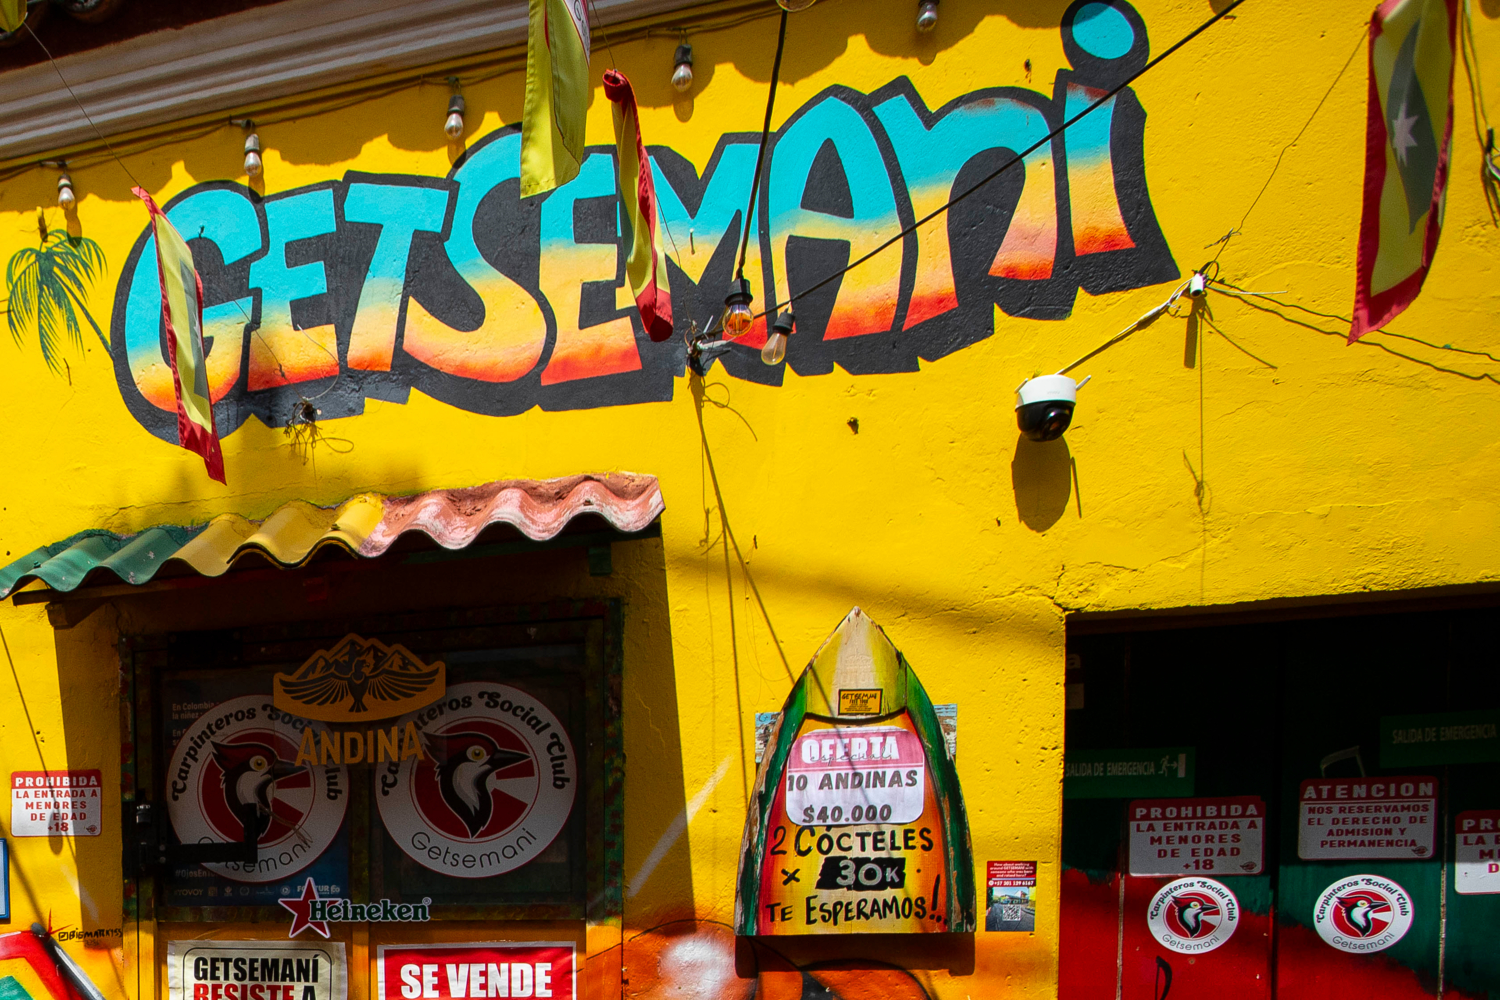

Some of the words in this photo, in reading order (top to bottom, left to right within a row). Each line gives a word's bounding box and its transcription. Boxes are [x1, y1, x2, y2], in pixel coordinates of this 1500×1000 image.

[477, 691, 551, 735] Social
[546, 732, 571, 790] Club
[1393, 728, 1423, 744] SALIDA
[1425, 727, 1437, 742] DE
[1440, 723, 1497, 741] EMERGENCIA
[171, 706, 257, 801] Carpinteros
[261, 703, 320, 746] Soci
[325, 758, 343, 801] lub
[294, 720, 425, 767] ANDINA
[801, 736, 900, 764] OFERTA
[1065, 762, 1092, 777] SALIDA
[1094, 762, 1104, 776] DE
[1106, 761, 1155, 776] EMERGENCIA
[15, 776, 98, 787] PROHIBIDA
[787, 774, 808, 791] 10
[818, 770, 918, 790] ANDINAS
[34, 789, 86, 798] ENTRADA
[91, 789, 98, 798] A
[1303, 782, 1433, 799] ATENCION
[25, 801, 87, 810] MENORES
[802, 804, 892, 823] $40.000
[1135, 804, 1258, 819] PROHIBIDA
[1308, 806, 1333, 814] NOS
[1338, 804, 1429, 814] RESERVAMOS
[31, 813, 46, 821] DE
[53, 812, 87, 821] EDAD
[1307, 818, 1324, 826] EL
[1331, 816, 1401, 826] DERECHO
[1409, 815, 1428, 824] DE
[1462, 818, 1500, 831] PR
[48, 822, 69, 832] +18
[1136, 823, 1156, 832] LA
[1163, 820, 1240, 832] ENTRADA
[1247, 820, 1258, 829] A
[1327, 828, 1393, 837] ADMISION
[1398, 828, 1407, 836] Y
[770, 825, 787, 856] 2
[1150, 833, 1242, 845] MENORES
[1320, 839, 1417, 848] PERMANENCIA
[1463, 835, 1486, 846] LA
[198, 837, 312, 874] tsemani
[411, 827, 537, 869] Getsemani
[1157, 848, 1180, 858] DE
[1191, 847, 1240, 857] EDAD
[1479, 849, 1500, 859] M
[1183, 859, 1214, 870] +18
[1149, 881, 1195, 920] Carpinteros
[1196, 880, 1229, 900] Social
[1225, 898, 1236, 922] Club
[1316, 880, 1360, 923] Carpinteros
[1361, 878, 1398, 895] Social
[1396, 893, 1410, 916] Club
[308, 899, 429, 921] Heineken
[765, 902, 793, 923] TE
[1161, 933, 1220, 951] Getsemani
[1332, 932, 1395, 950] Getsemani
[193, 954, 320, 983] GETSEMANÍ
[400, 963, 440, 999] SE
[445, 962, 553, 998] VENDE
